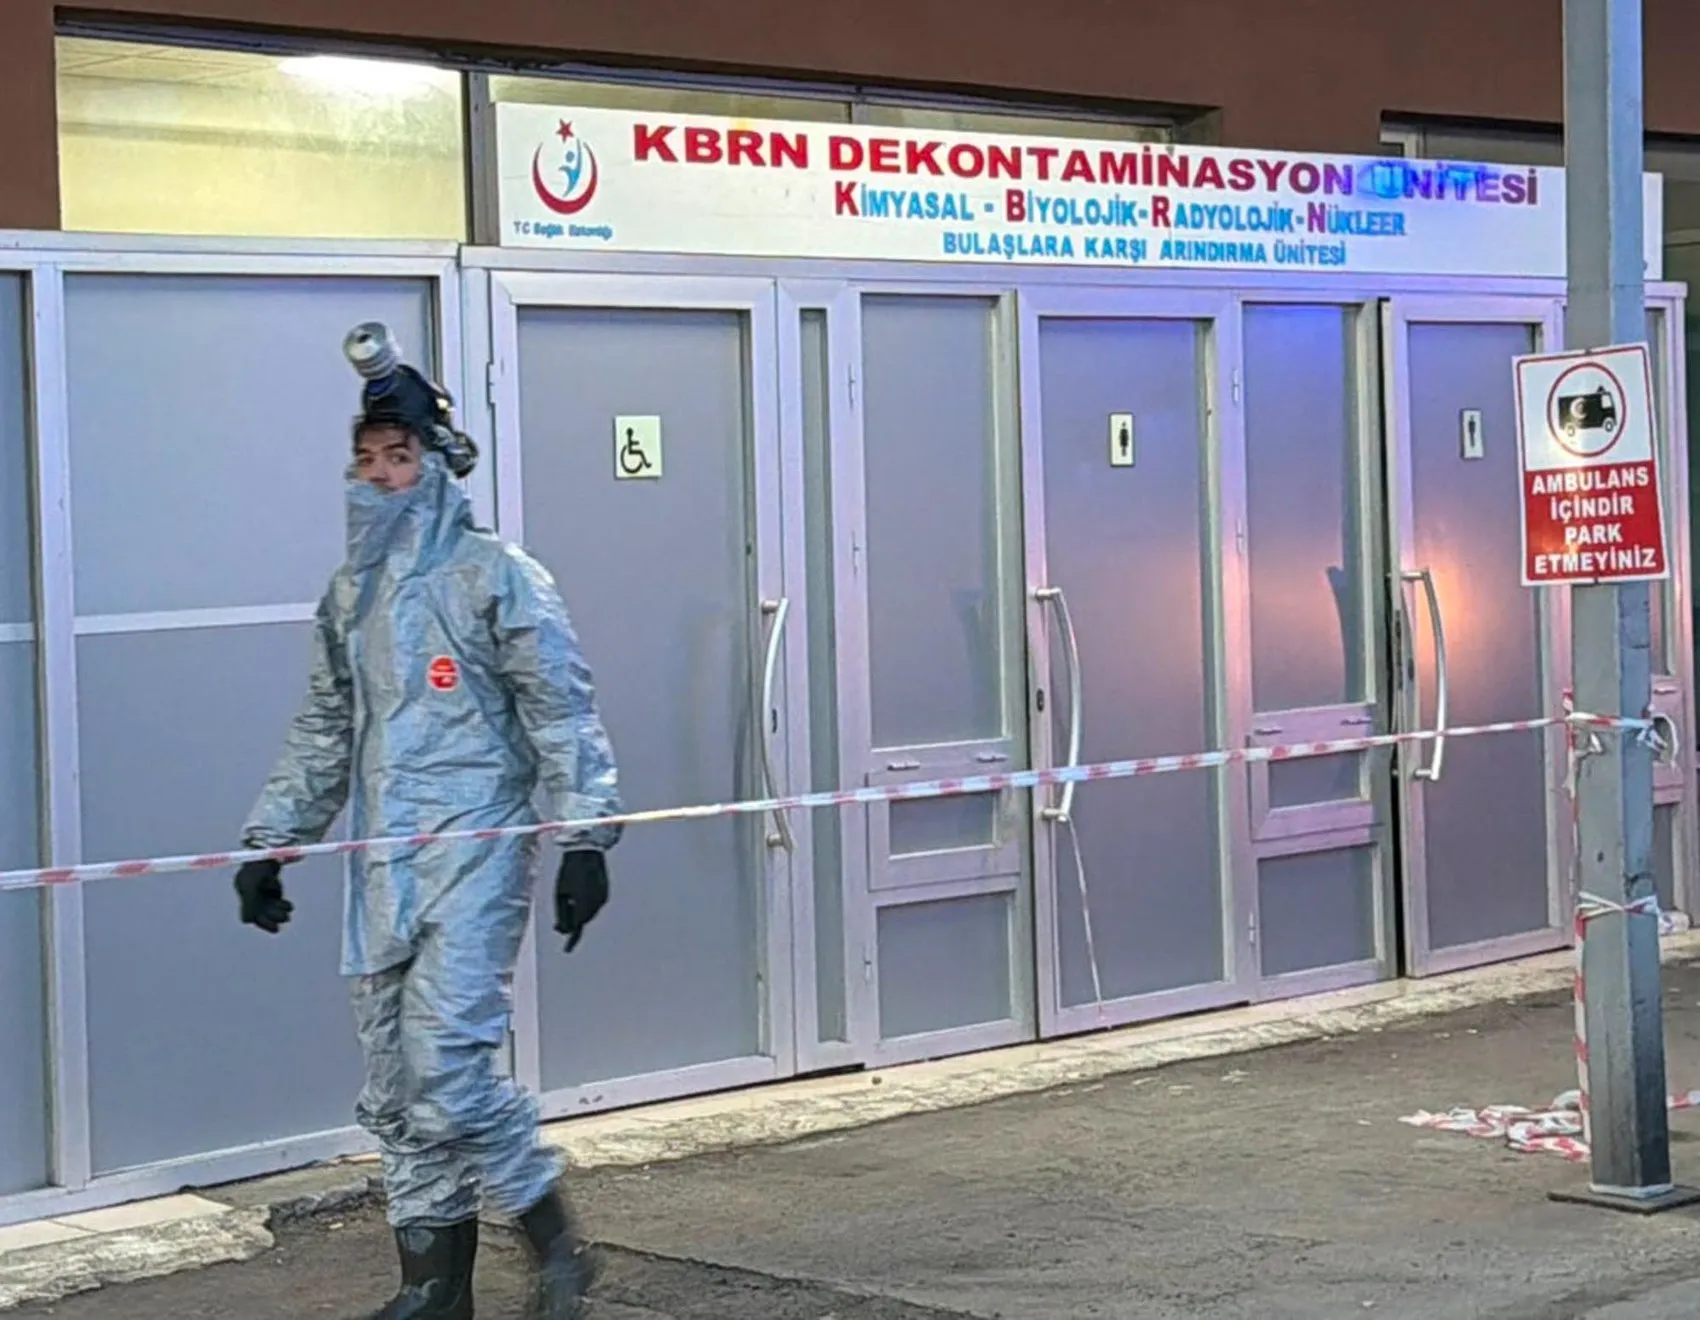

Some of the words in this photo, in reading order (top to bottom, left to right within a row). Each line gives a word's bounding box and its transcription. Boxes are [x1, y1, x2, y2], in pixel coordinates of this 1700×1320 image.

[633, 123, 808, 169] KBRN
[828, 135, 1353, 195] DEKONTAMİNASYON
[834, 181, 975, 222] KİMYASAL
[942, 232, 1075, 260] BULAŞLARA
[1084, 236, 1147, 263] KARŞI
[1159, 240, 1267, 264] ARINDIRMA
[1273, 240, 1346, 266] ÜNİTESİ
[1532, 466, 1649, 495] AMBULANS
[1550, 492, 1635, 524] İÇİNDİR
[1564, 523, 1624, 546] PARK
[1534, 545, 1656, 575] ETMEYİNİZ
